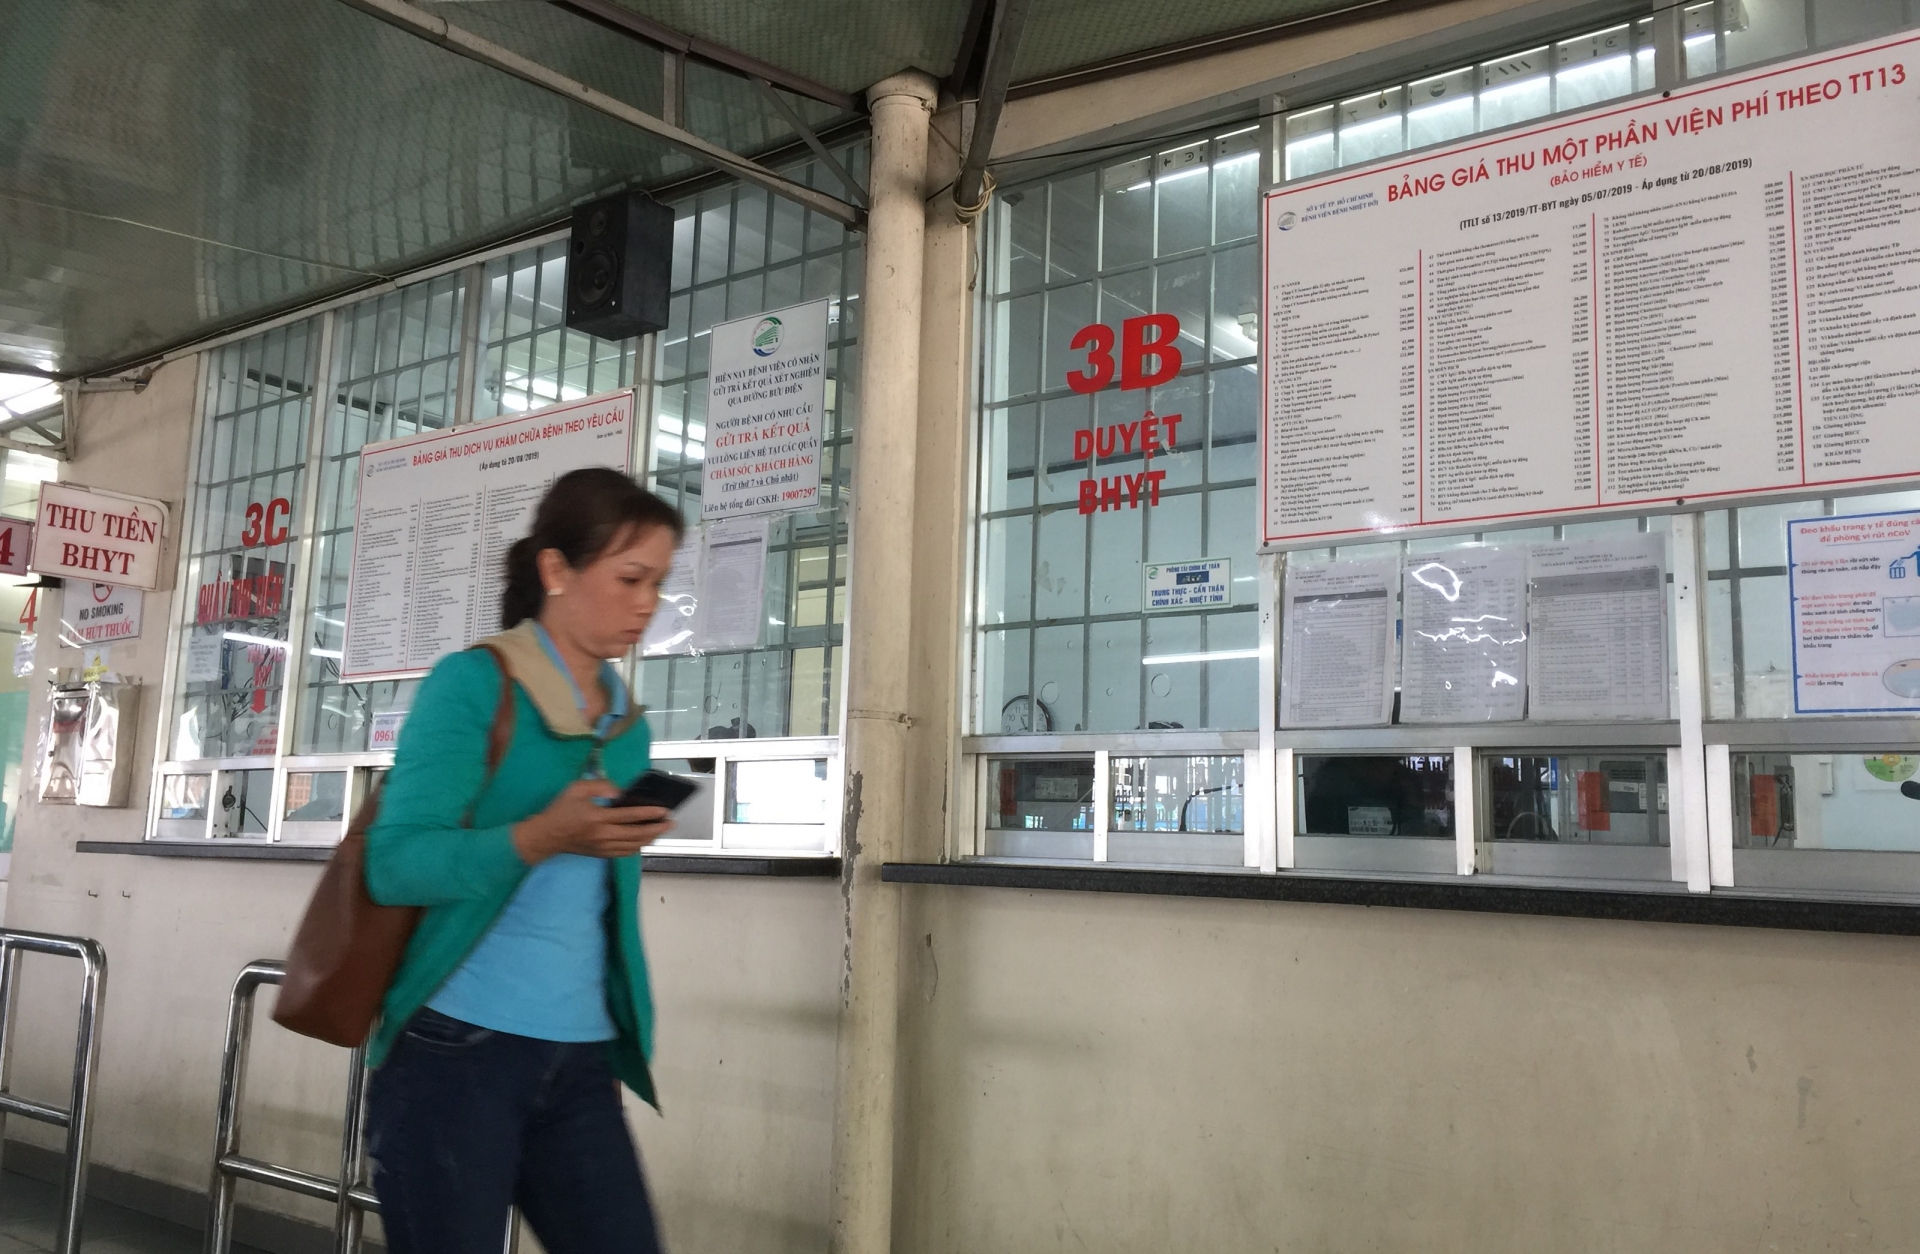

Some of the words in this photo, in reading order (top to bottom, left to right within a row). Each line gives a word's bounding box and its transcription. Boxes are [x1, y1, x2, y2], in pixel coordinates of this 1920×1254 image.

[1388, 174, 1446, 202] BẢNG
[1452, 158, 1490, 187] GIÁ
[1496, 152, 1535, 177] THU
[1543, 138, 1588, 166] MỘT
[1596, 118, 1658, 154] PHẦN
[1666, 106, 1723, 136] VIỆN
[1732, 90, 1768, 122] PHÍ
[1776, 79, 1842, 111] THEO
[1848, 64, 1906, 94] TT13
[1550, 170, 1578, 188] (BẢO
[1582, 161, 1613, 180] HIỂM
[1617, 159, 1624, 170] Y
[1629, 152, 1648, 168] TẾ)
[1460, 219, 1479, 231] (TTLT
[1481, 214, 1490, 226] số
[1492, 201, 1557, 222] 13/2019/TT-BYT
[1559, 197, 1579, 210] ngày
[1582, 184, 1633, 203] 05/07/2019
[1642, 177, 1653, 192] Áp
[1656, 175, 1678, 188] dụng
[1680, 170, 1691, 182] từ
[1693, 158, 1752, 181] 20/08/2019)
[1066, 313, 1183, 394] 3B
[713, 383, 727, 397] GỬI
[728, 380, 741, 393] TRẢ
[742, 377, 757, 390] KẾT
[758, 374, 772, 389] QUẢ
[774, 372, 788, 385] XÉT
[789, 366, 820, 381] NGHIỆM
[715, 372, 732, 384] HIỆN
[733, 370, 746, 380] NAY
[748, 365, 767, 377] BỆNH
[769, 360, 786, 372] VIỆN
[787, 357, 798, 368] CÓ
[799, 354, 820, 366] NHẬN
[728, 395, 742, 407] QUA
[743, 389, 767, 402] ĐƯỜNG
[769, 386, 783, 397] BƯU
[784, 383, 803, 395] ĐIỆN
[716, 417, 740, 431] NGƯỜI
[742, 412, 763, 426] BỆNH
[765, 408, 775, 421] CÓ
[778, 408, 794, 419] NHU
[796, 402, 813, 416] CẦU
[413, 450, 432, 466] BẢNG
[435, 447, 446, 462] GIÁ
[450, 446, 462, 458] THU
[464, 443, 481, 457] DỊCH
[483, 439, 493, 453] VỤ
[496, 433, 517, 449] KHÁM
[519, 428, 540, 443] CHỮA
[543, 424, 563, 440] BỆNH
[565, 419, 584, 433] THEO
[588, 414, 603, 428] YÊU
[606, 406, 624, 424] CẦU
[716, 431, 735, 449] GỬI
[737, 426, 758, 444] TRẢ
[762, 422, 784, 439] KẾT
[787, 417, 810, 436] QUẢ
[1074, 410, 1182, 460] DUYỆT
[479, 461, 488, 471] (Áp
[489, 459, 500, 469] dụng
[502, 458, 508, 466] từ
[508, 451, 539, 464] 20/08/2019)
[707, 453, 719, 465] VUI
[720, 449, 738, 463] LÒNG
[739, 447, 756, 461] LIÊN
[757, 445, 767, 457] HỆ
[768, 444, 780, 456] TẠI
[781, 441, 796, 453] CÁC
[797, 438, 818, 453] QUẦY
[710, 467, 735, 480] CHĂM
[736, 462, 753, 476] SÓC
[755, 457, 786, 473] KHÁCH
[788, 454, 813, 468] HÀNG
[722, 479, 736, 492] (Trừ
[738, 478, 749, 490] thứ
[750, 477, 755, 486] 7
[756, 476, 764, 485] và
[765, 474, 778, 485] Chủ
[780, 472, 799, 484] nhật)
[704, 499, 718, 513] Liên
[720, 496, 728, 511] hệ
[729, 495, 743, 509] tổng
[744, 494, 755, 506] đài
[756, 493, 779, 505] CSKH:
[781, 487, 816, 502] 19007297
[1078, 470, 1166, 515] BHYT
[46, 503, 96, 533] THU
[103, 505, 158, 544] TIỀN
[242, 497, 290, 548] 3C
[1820, 523, 1841, 534] khẩu
[1842, 523, 1866, 532] trang
[1887, 519, 1909, 529] đúng
[1820, 534, 1831, 543] để
[1834, 533, 1860, 543] phòng
[1872, 530, 1886, 538] rút
[0, 527, 15, 567] 4
[60, 542, 135, 576] BHYT
[1152, 598, 1169, 606] CHÍNH
[1190, 596, 1207, 604] NHIỆT
[1172, 588, 1187, 596] THỰC
[1209, 584, 1224, 593] THẬN
[20, 586, 38, 635] 4
[79, 608, 89, 621] NO
[91, 603, 123, 619] SMOKING
[85, 622, 103, 640] HÚT
[104, 615, 134, 637] THUỐC
[374, 730, 395, 742] 0961
